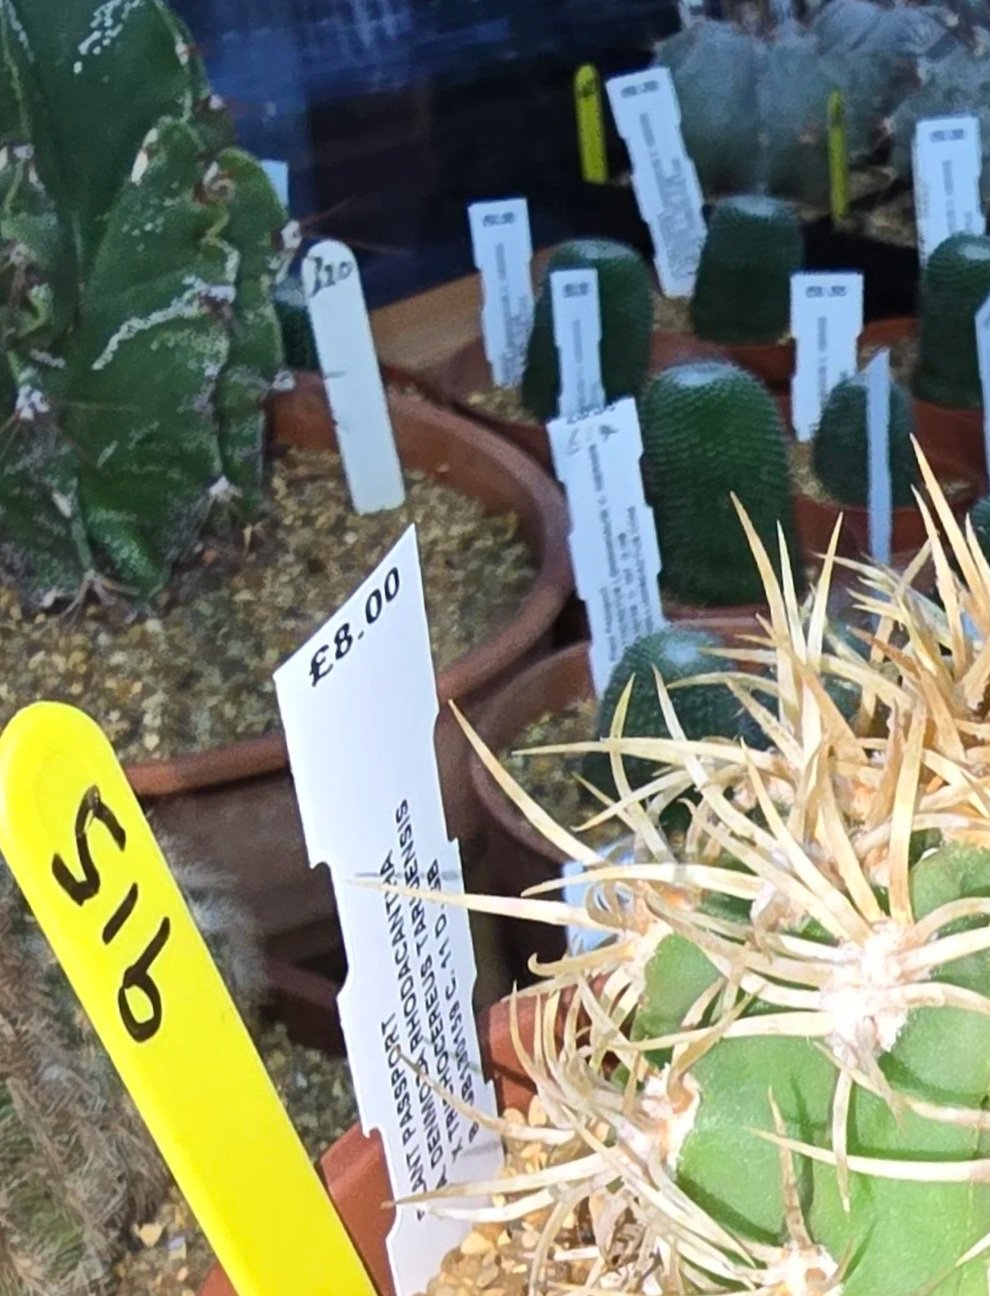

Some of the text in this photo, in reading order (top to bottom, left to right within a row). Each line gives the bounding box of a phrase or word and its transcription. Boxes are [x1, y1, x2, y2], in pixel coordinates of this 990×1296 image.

[309, 566, 400, 687] £8.00
[438, 937, 452, 969] 11
[381, 1012, 417, 1146] PASSPORT
